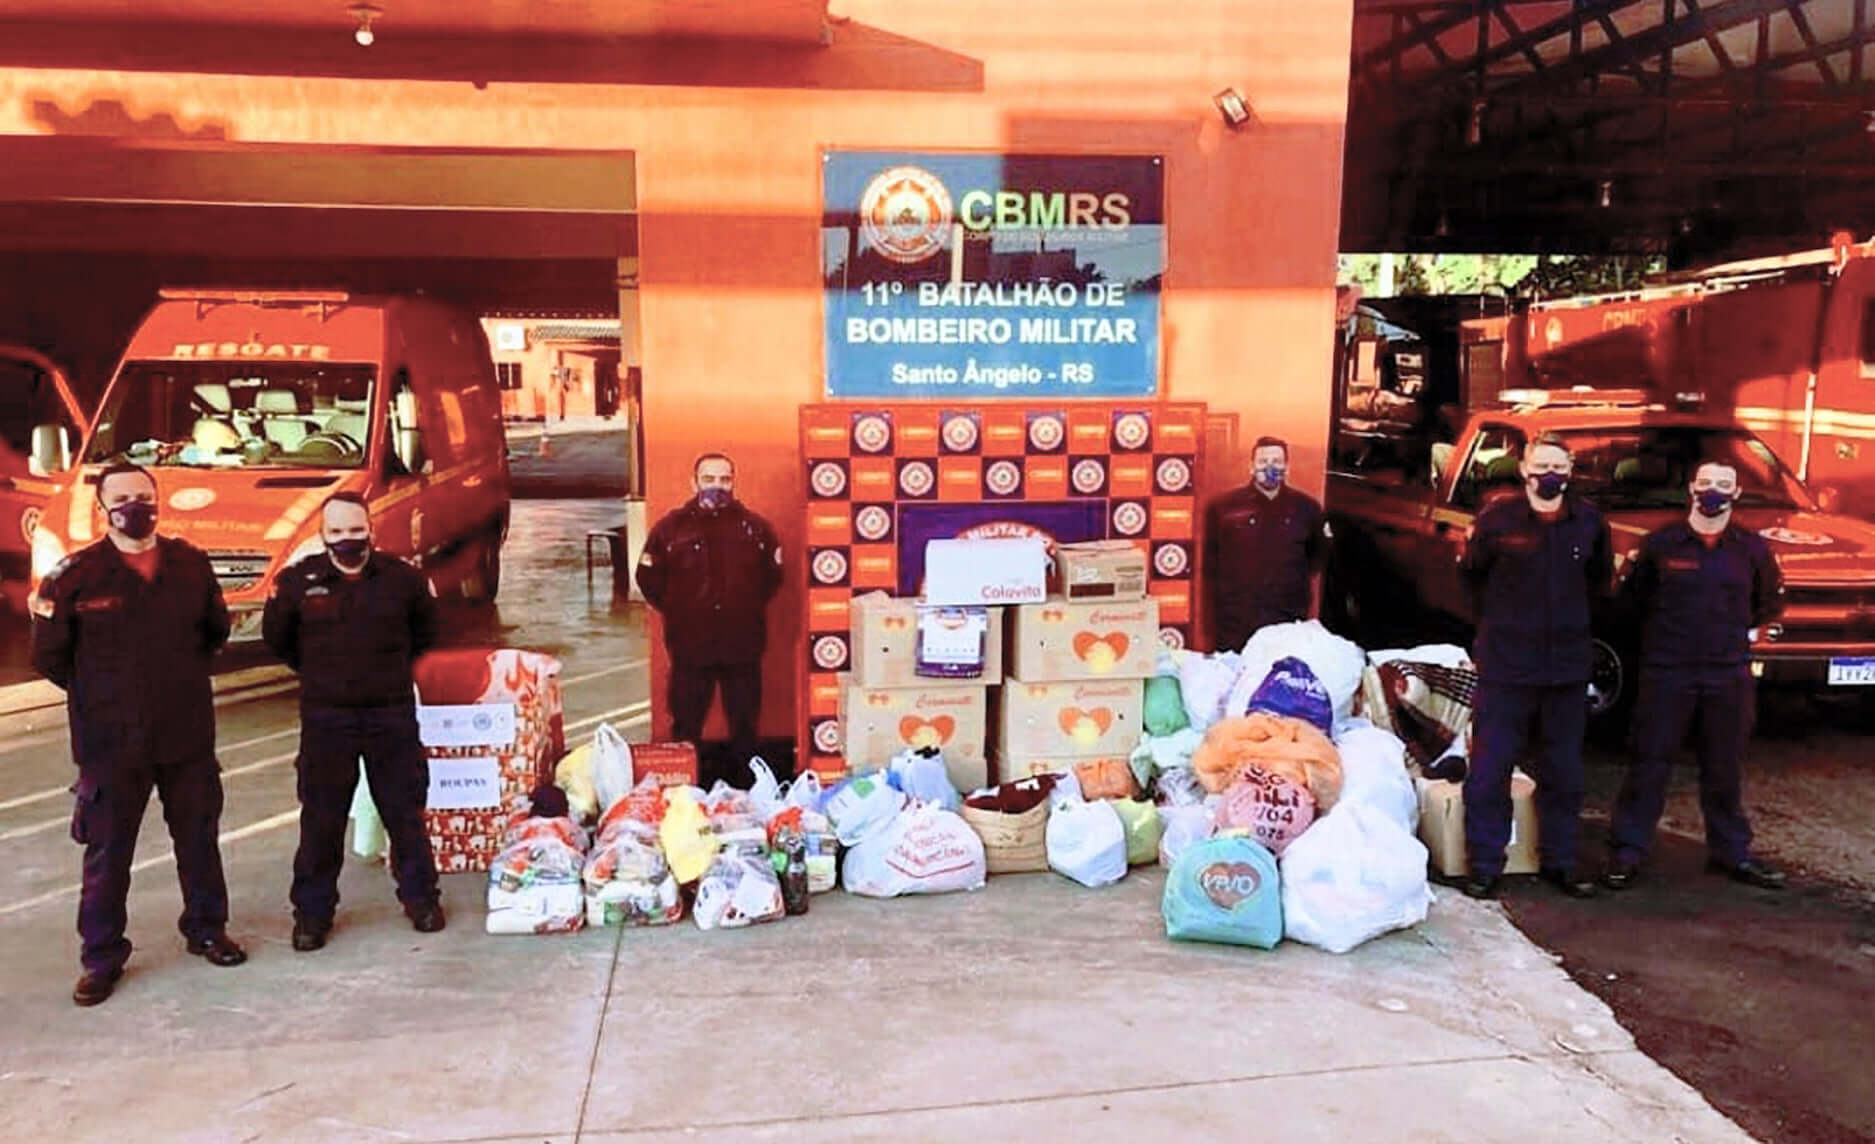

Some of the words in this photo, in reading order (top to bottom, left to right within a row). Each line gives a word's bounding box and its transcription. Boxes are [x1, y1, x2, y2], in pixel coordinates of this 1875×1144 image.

[960, 189, 1131, 231] CBMRS
[919, 277, 1076, 307] BATALHÃO
[1086, 282, 1126, 307] DE
[847, 317, 1011, 345] BOMBEIRO
[1019, 317, 1137, 345] MILITAR
[173, 342, 330, 361] RESGATE
[892, 364, 957, 384] Santo
[963, 360, 1041, 387] Ângelo
[1062, 364, 1094, 384] RS
[981, 584, 1042, 600] Colavita
